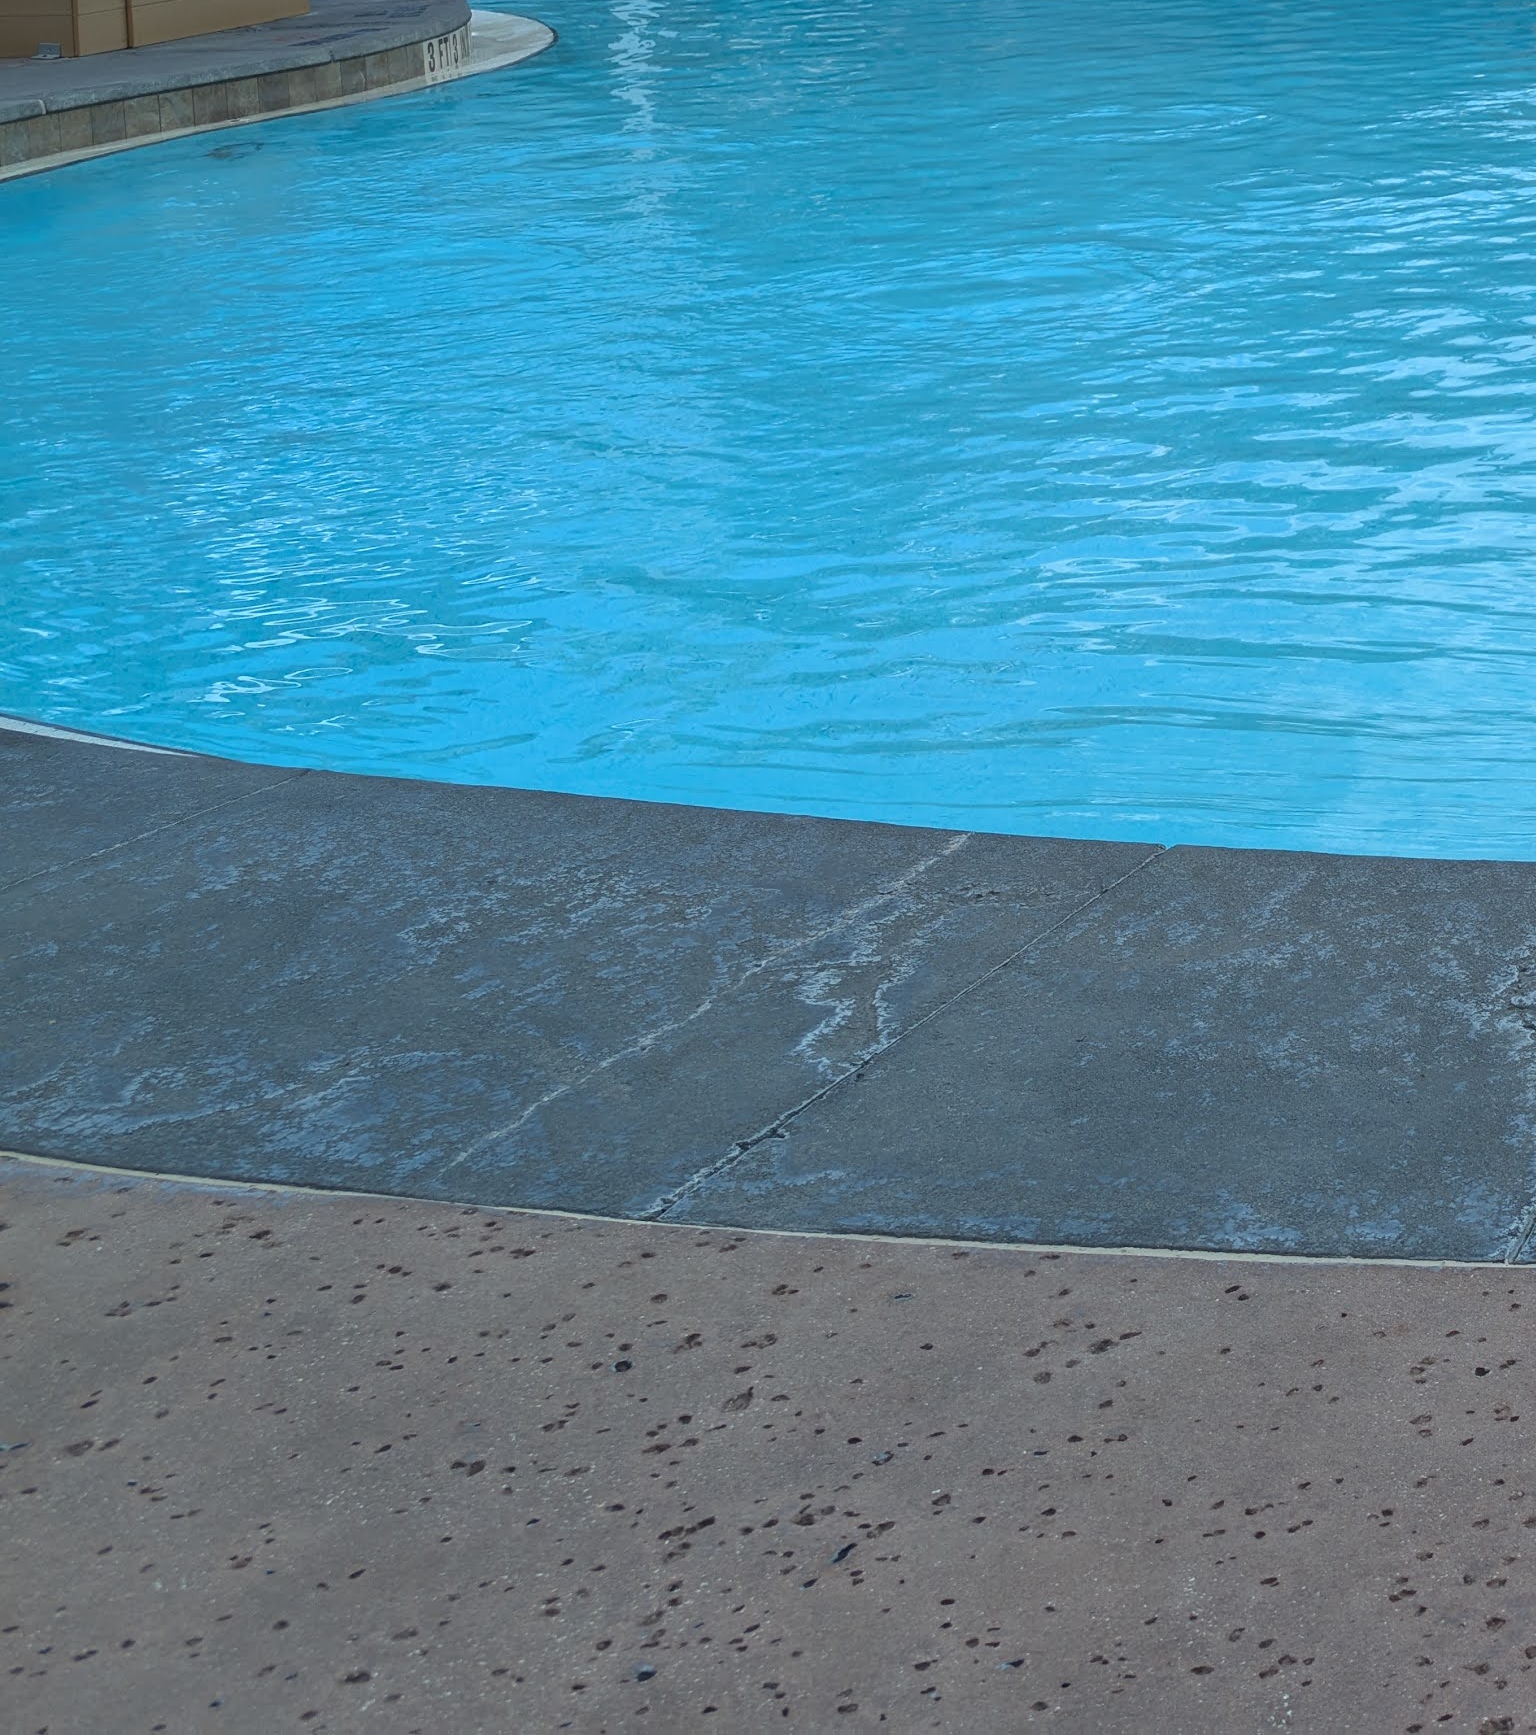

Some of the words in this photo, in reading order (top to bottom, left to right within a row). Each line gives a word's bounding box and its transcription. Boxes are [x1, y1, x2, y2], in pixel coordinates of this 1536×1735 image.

[428, 41, 436, 73] 3
[438, 36, 449, 69] FT
[452, 33, 459, 64] 3
